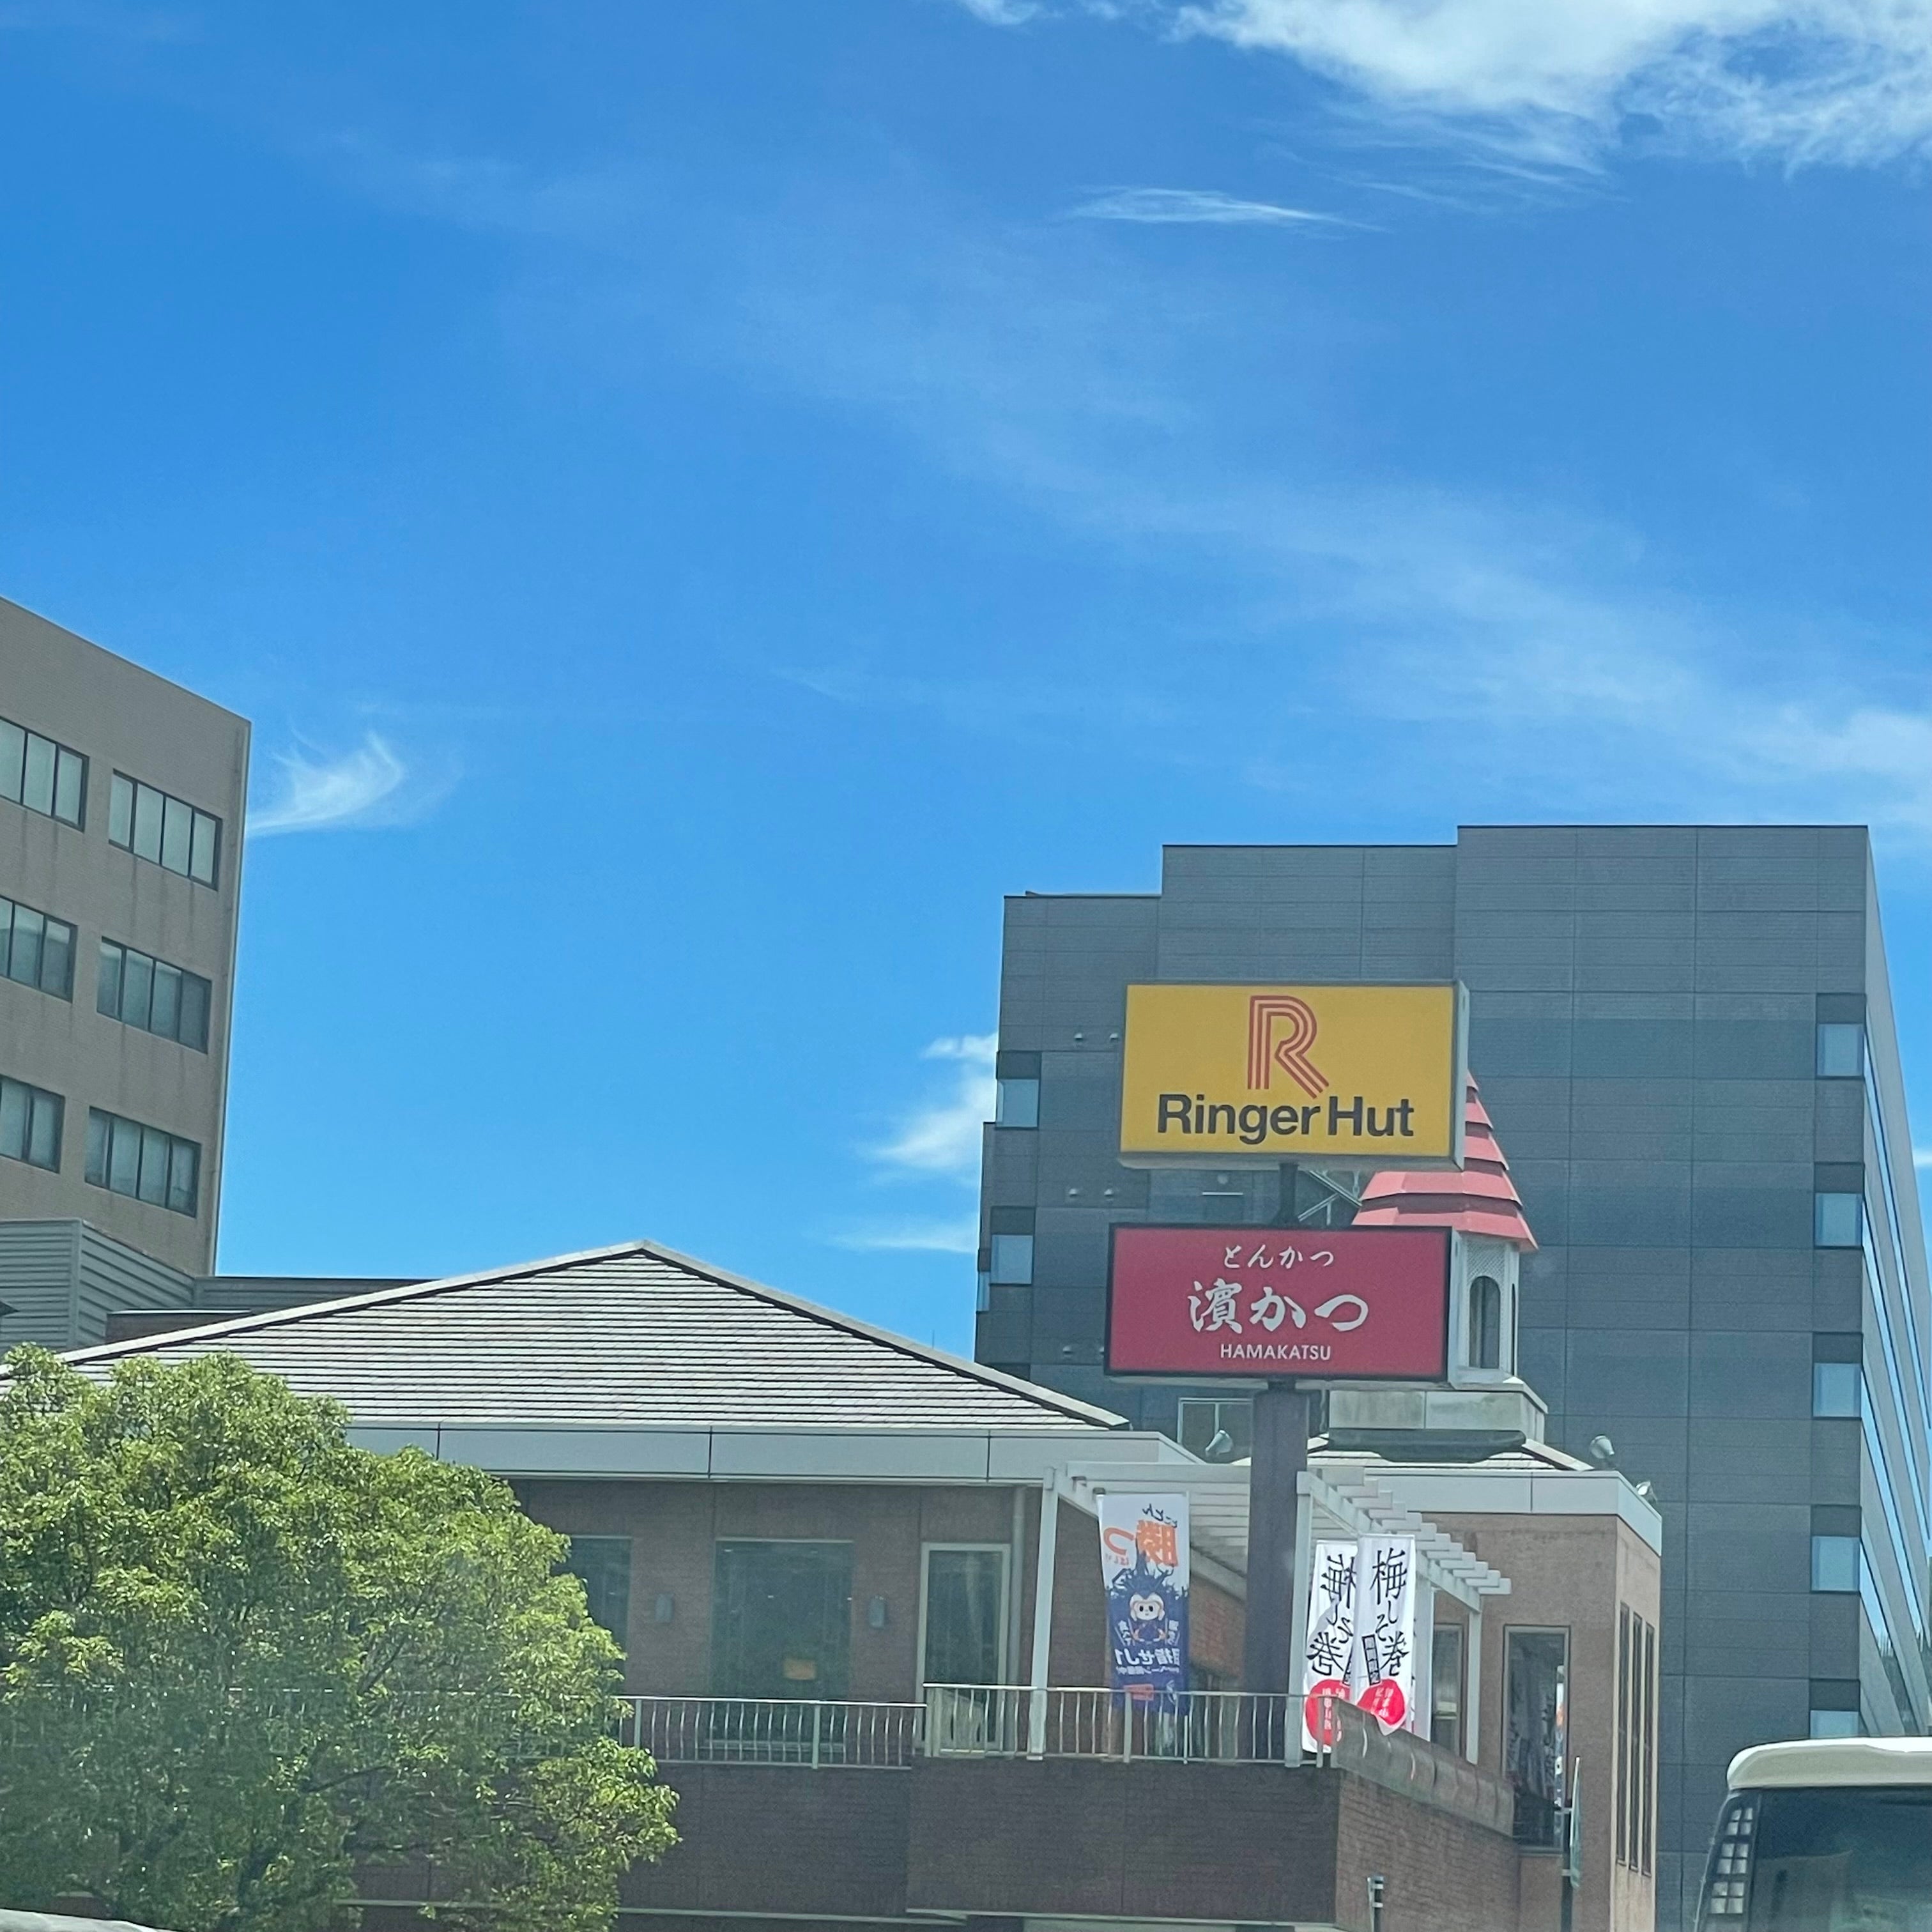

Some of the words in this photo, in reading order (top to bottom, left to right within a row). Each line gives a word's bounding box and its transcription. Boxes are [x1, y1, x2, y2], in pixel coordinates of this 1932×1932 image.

[1157, 1093, 1321, 1145] Ringer
[1328, 1096, 1414, 1137] Hut
[1223, 1244, 1335, 1269] とんかつ
[1187, 1277, 1369, 1334] 濱かつ
[1220, 1344, 1331, 1360] HAMAKATSU
